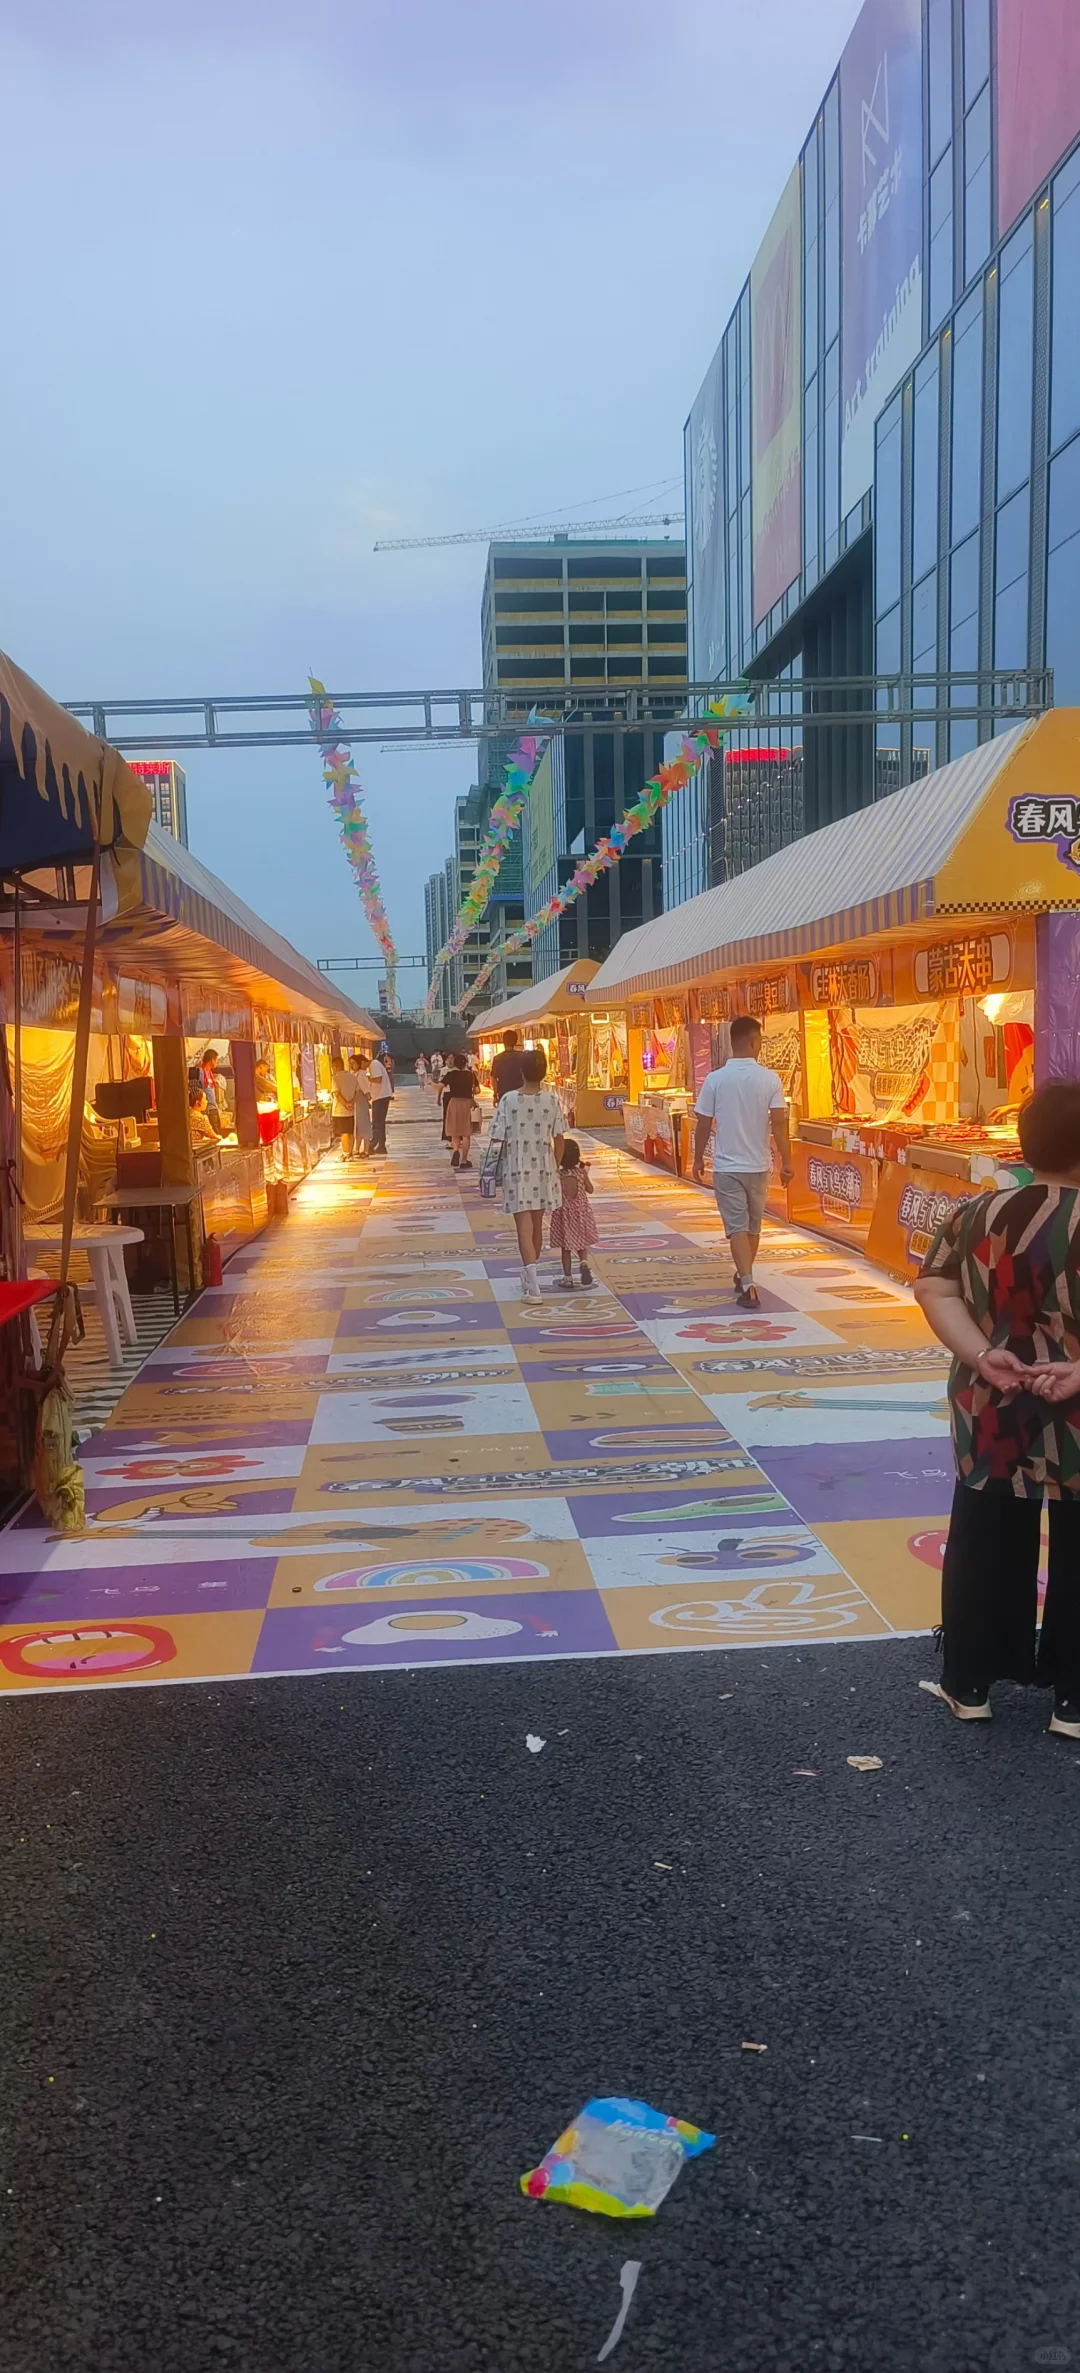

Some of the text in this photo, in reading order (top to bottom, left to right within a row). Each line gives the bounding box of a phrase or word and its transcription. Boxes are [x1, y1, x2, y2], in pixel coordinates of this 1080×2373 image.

[864, 252, 920, 388] training
[1017, 803, 1080, 834] 春风
[928, 938, 993, 996] 蒙古大串
